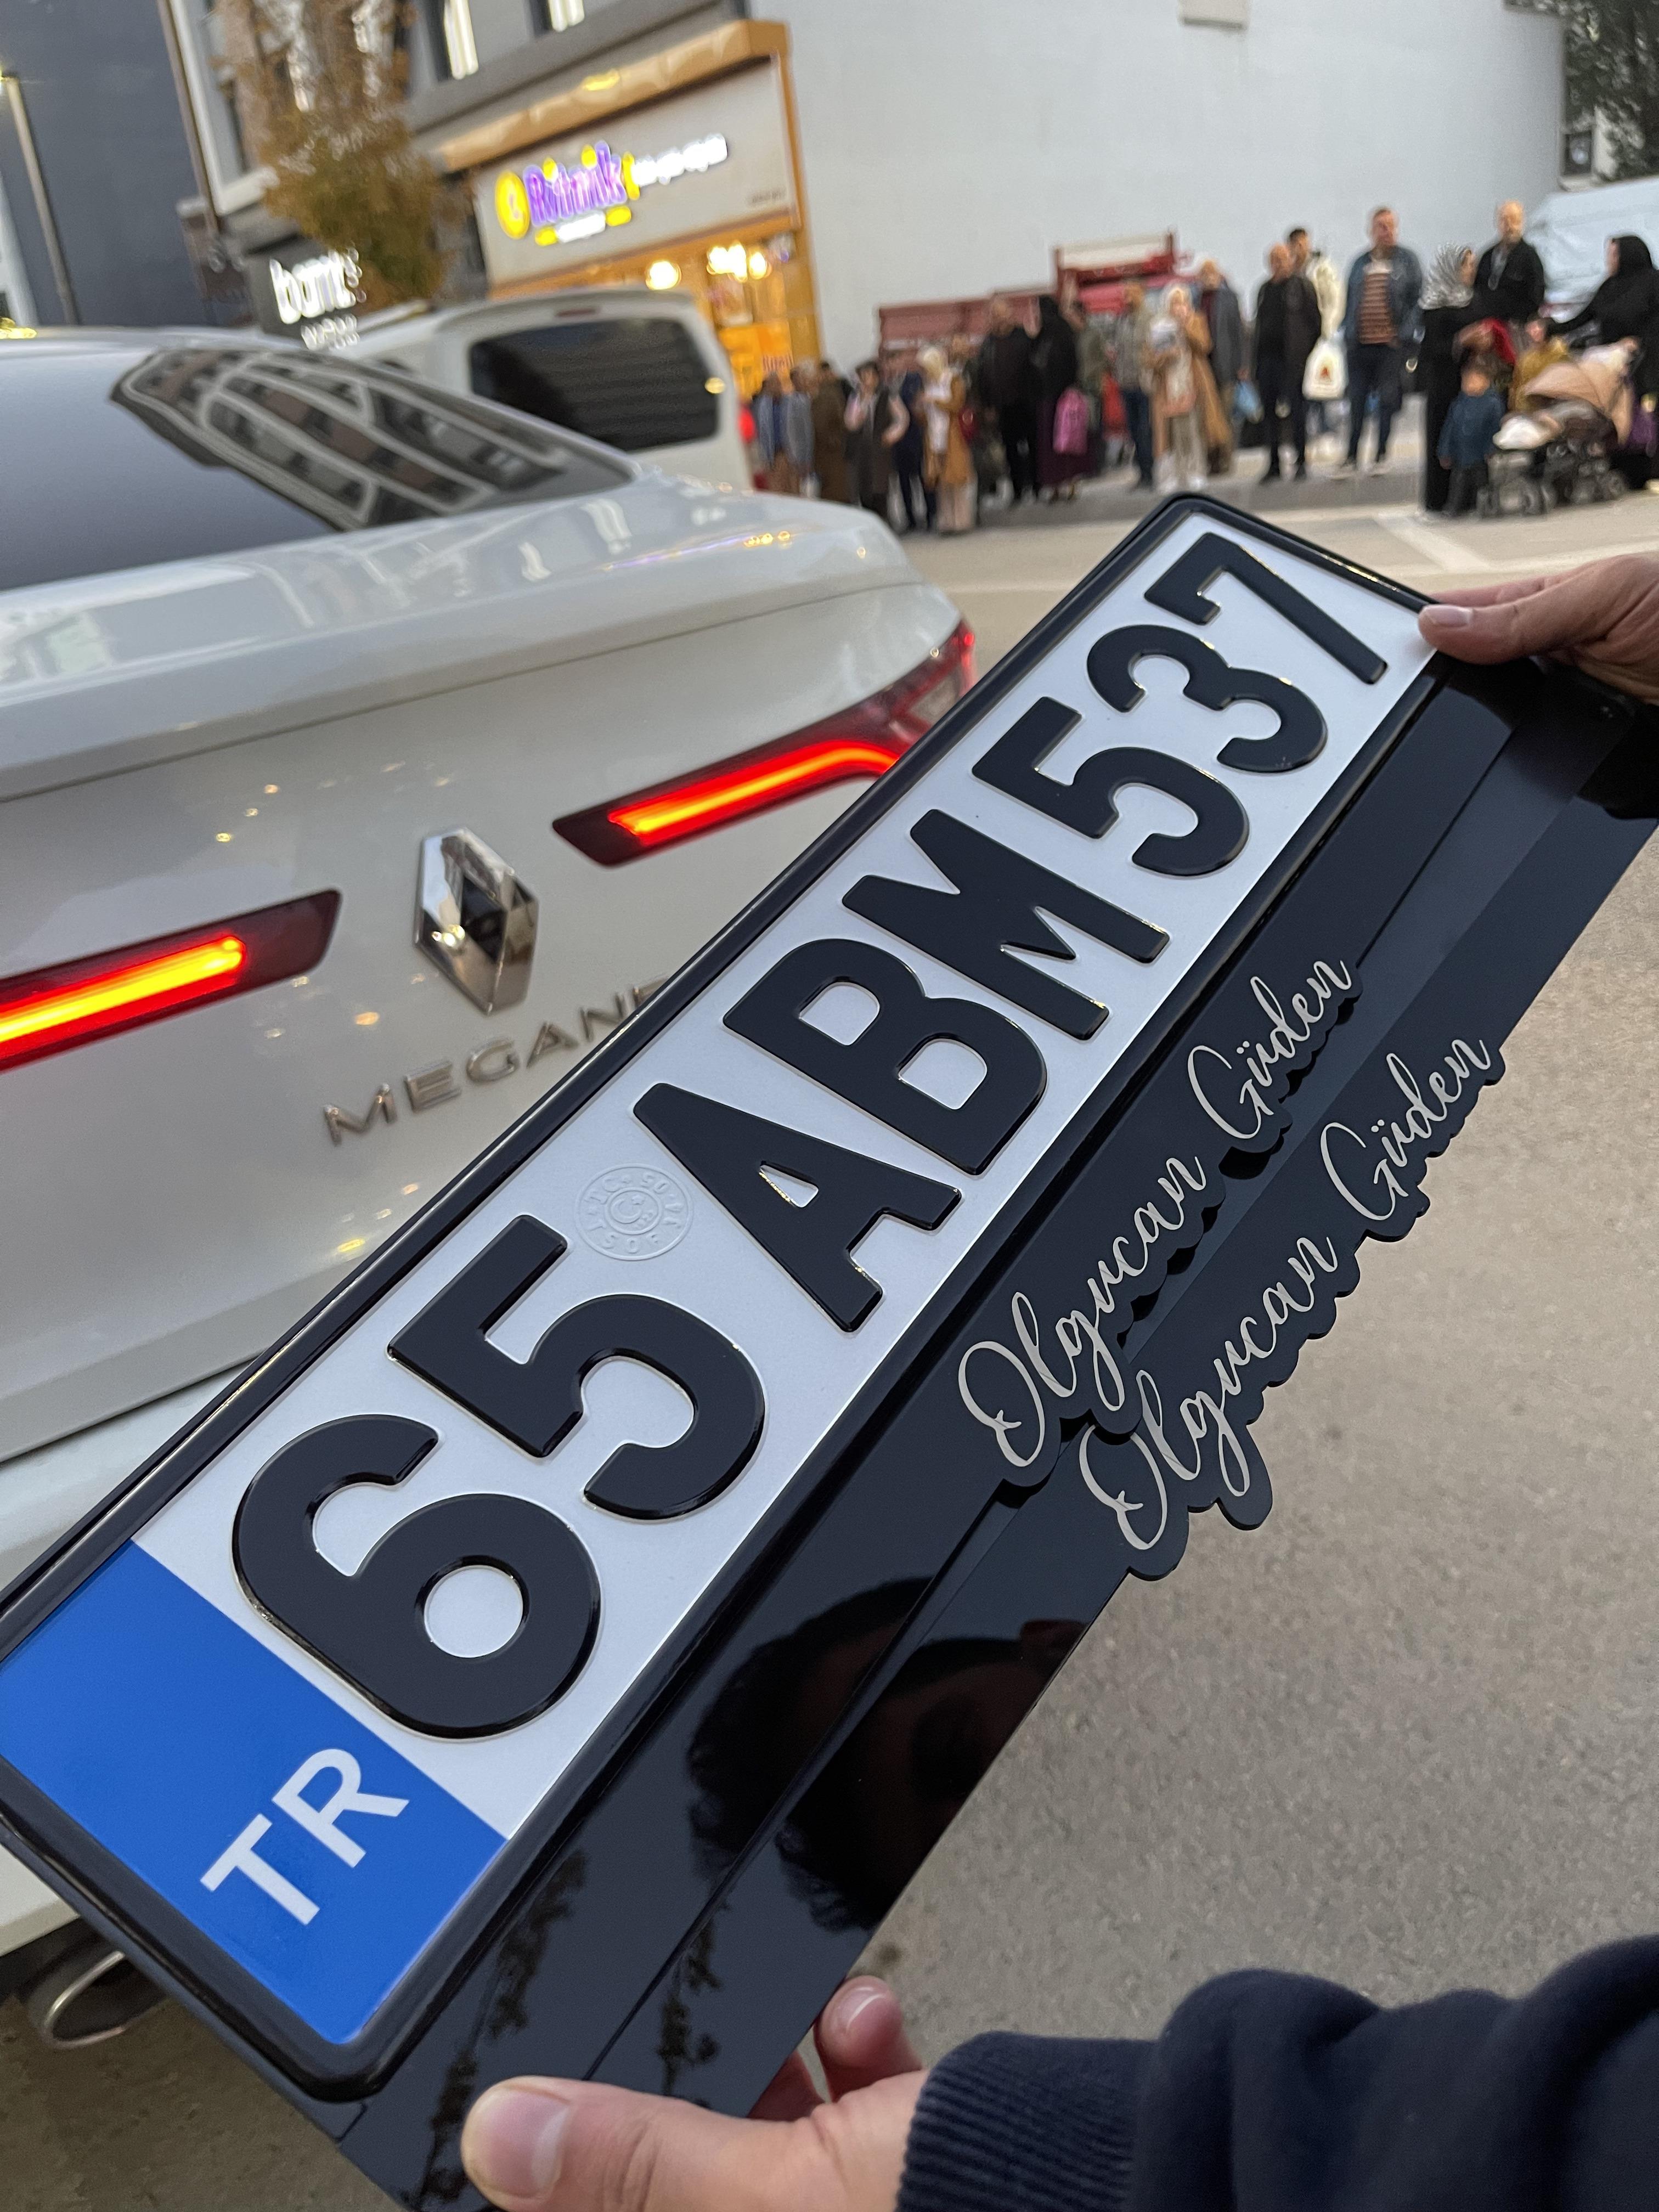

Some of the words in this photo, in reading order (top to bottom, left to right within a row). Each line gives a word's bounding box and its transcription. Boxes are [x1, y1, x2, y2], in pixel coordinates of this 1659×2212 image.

[230, 1214, 766, 1740] 65
[631, 808, 1171, 1334] ABM
[971, 532, 1389, 878] 537
[323, 977, 668, 1147] MEGAN
[1187, 960, 1352, 1139] Güden
[1320, 1039, 1491, 1221] Güden
[200, 1748, 409, 1925] TR
